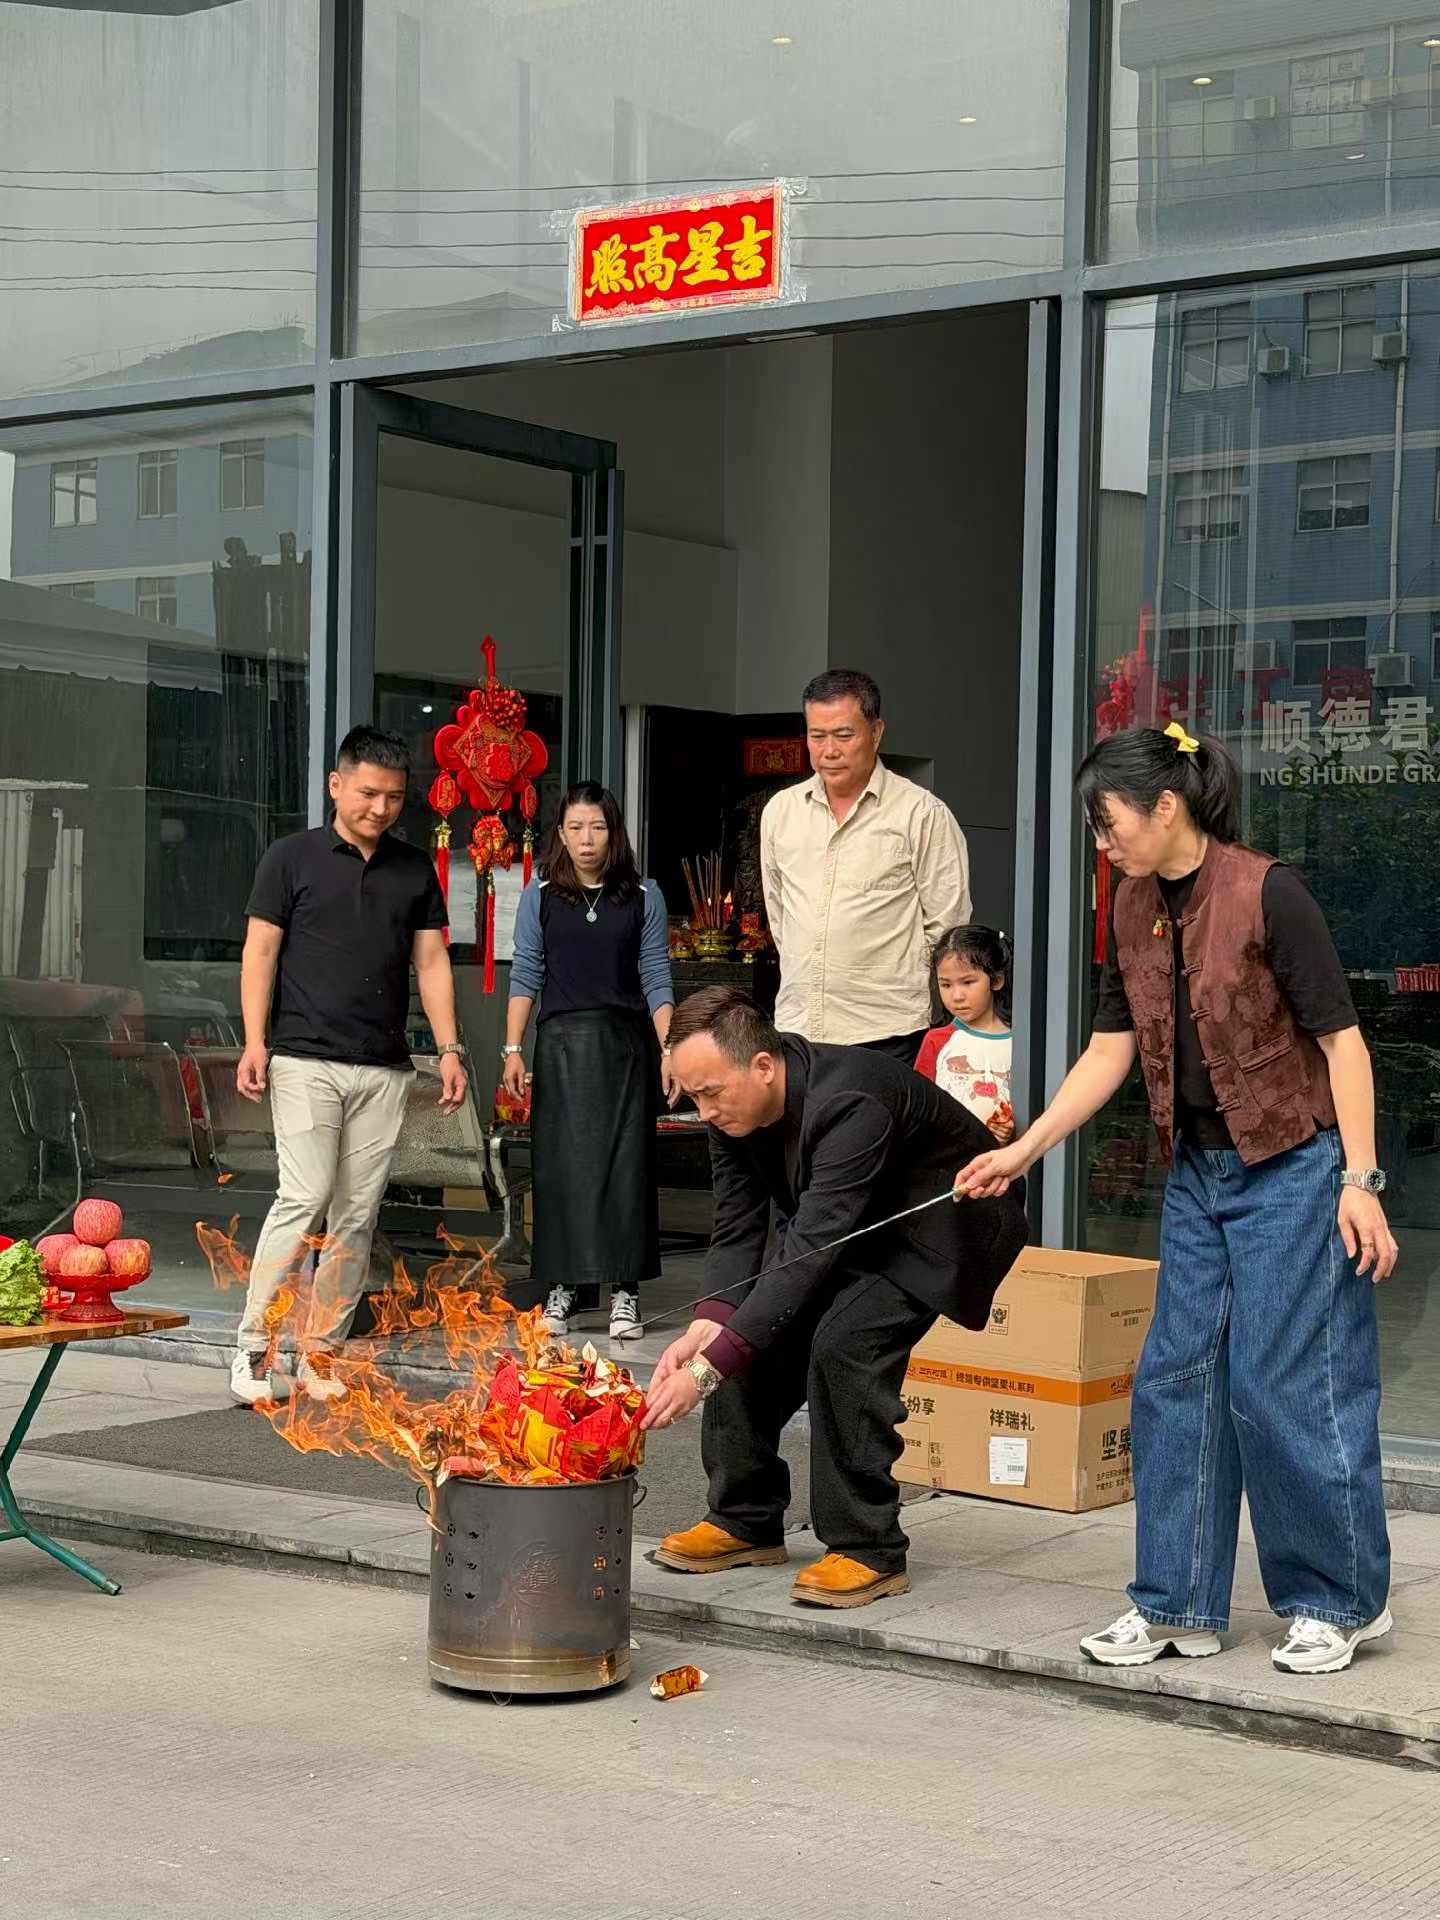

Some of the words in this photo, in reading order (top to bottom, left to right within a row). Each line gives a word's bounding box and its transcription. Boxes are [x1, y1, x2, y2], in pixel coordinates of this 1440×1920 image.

[1261, 695, 1434, 753] 顺德君
[1300, 765, 1397, 784] SHUNDE
[989, 1408, 1036, 1432] 祥瑞礼
